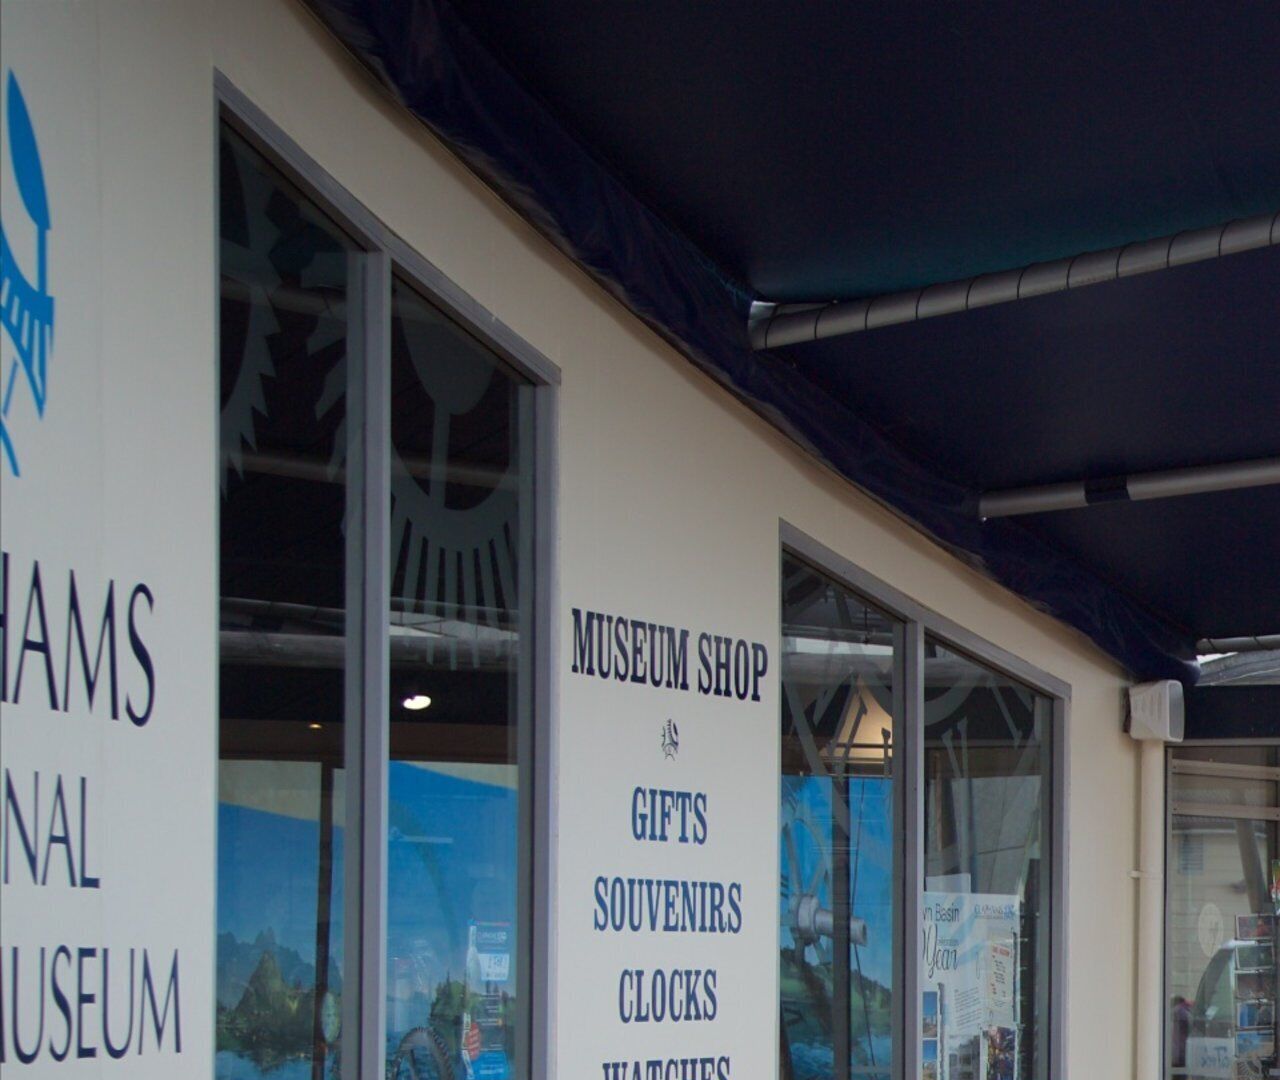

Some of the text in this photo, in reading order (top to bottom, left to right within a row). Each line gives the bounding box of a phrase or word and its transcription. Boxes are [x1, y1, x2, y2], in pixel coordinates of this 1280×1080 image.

[571, 608, 769, 702] MUSEUM SHOP
[3, 768, 100, 889] NAL
[631, 786, 708, 845] GIFTS
[593, 875, 743, 934] SOUVENIRS
[0, 945, 181, 1065] USEUM
[619, 969, 718, 1024] CLOCKS
